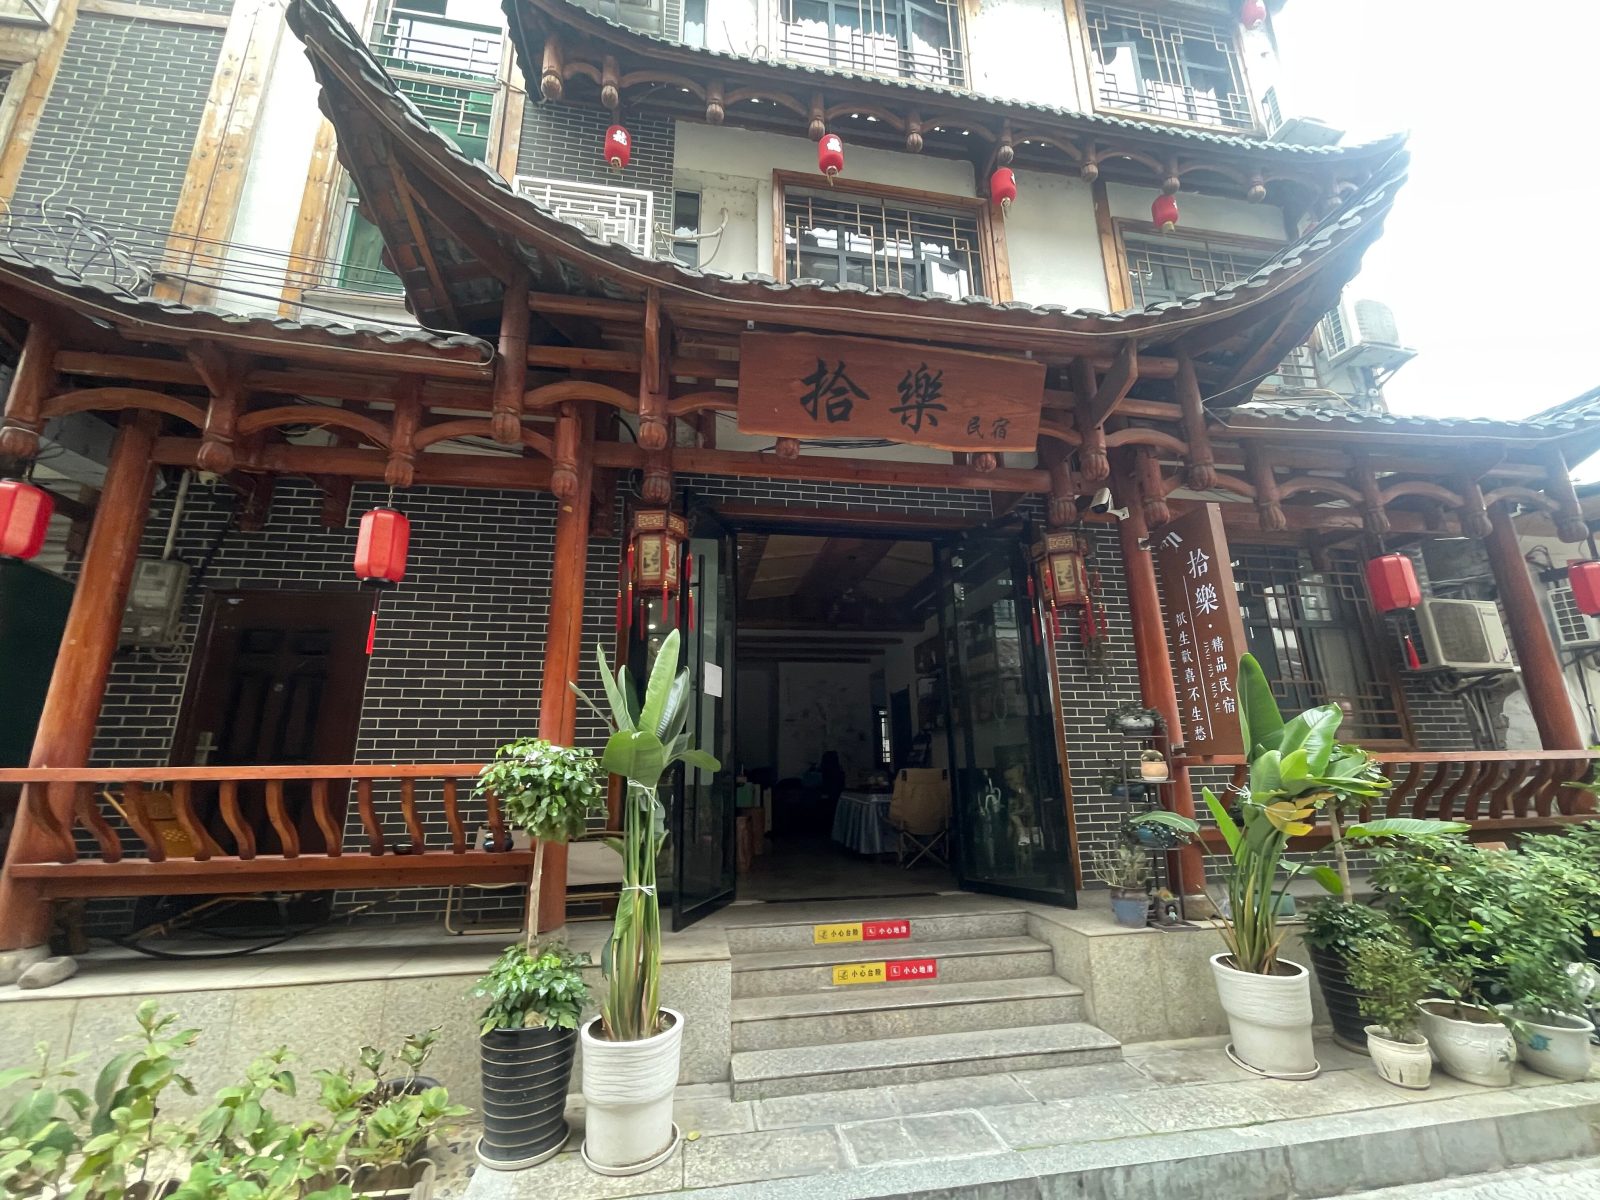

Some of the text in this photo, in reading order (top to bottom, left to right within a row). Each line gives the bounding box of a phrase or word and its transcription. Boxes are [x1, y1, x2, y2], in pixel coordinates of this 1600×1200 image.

[800, 357, 948, 433] 拾樂
[967, 416, 1010, 440] 民宿
[830, 929, 859, 938] 小心台阶
[879, 926, 907, 935] 小心地滑
[852, 968, 882, 978] 小心台阶
[903, 964, 934, 974] 小心地滑
